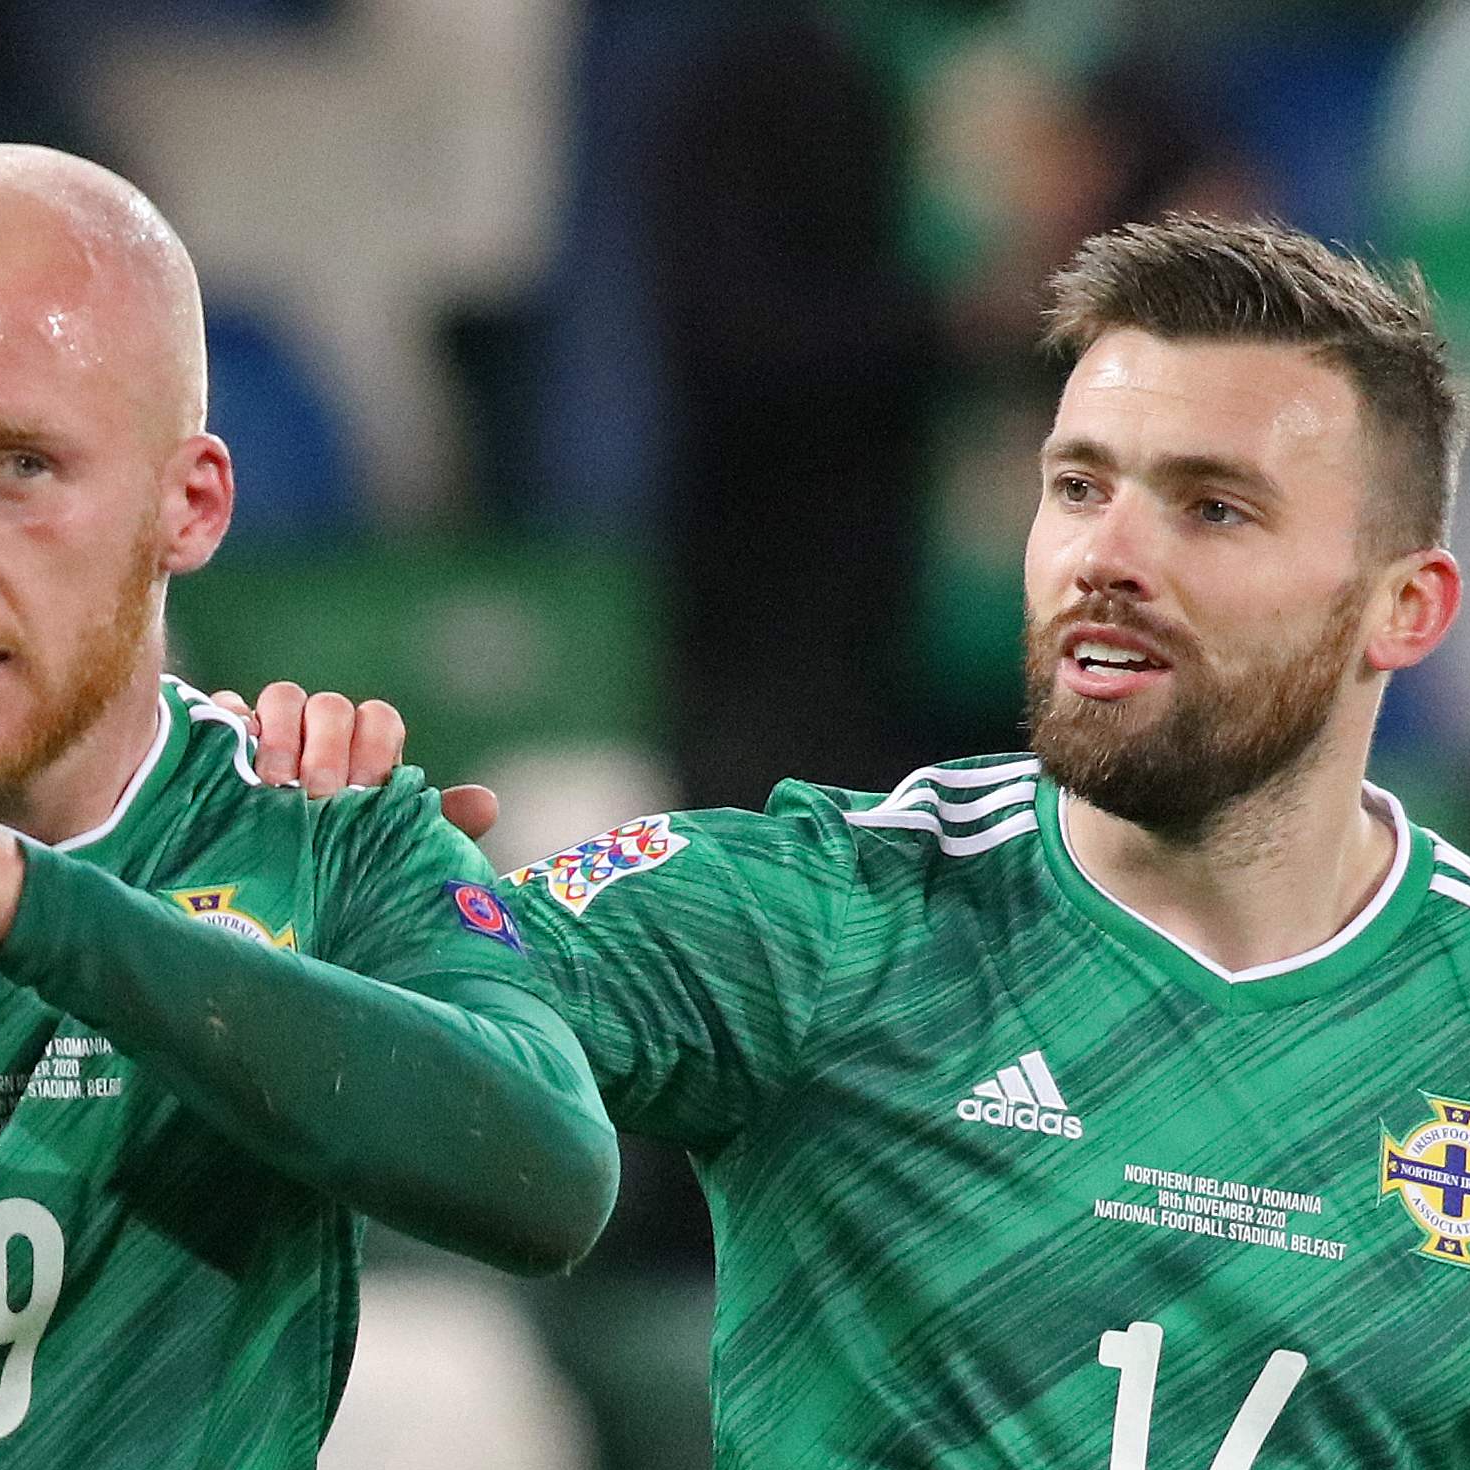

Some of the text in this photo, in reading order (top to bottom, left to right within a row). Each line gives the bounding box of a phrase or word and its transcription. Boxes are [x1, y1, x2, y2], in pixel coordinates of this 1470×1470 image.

[54, 1037, 113, 1057] ROMANIA
[53, 1060, 80, 1077] 2020
[28, 1080, 86, 1099] STADIUM,
[956, 1098, 1083, 1139] adidas
[1411, 1127, 1440, 1156] IRISH
[1124, 1164, 1322, 1214] NORTHERN IRELAND V ROMANIA
[1401, 1163, 1459, 1186] NORTHERN
[1158, 1189, 1286, 1228] 18th NOVEMBER 2020
[1094, 1199, 1347, 1261] NATIONAL FOOTBALL STADIUM, BELFAST
